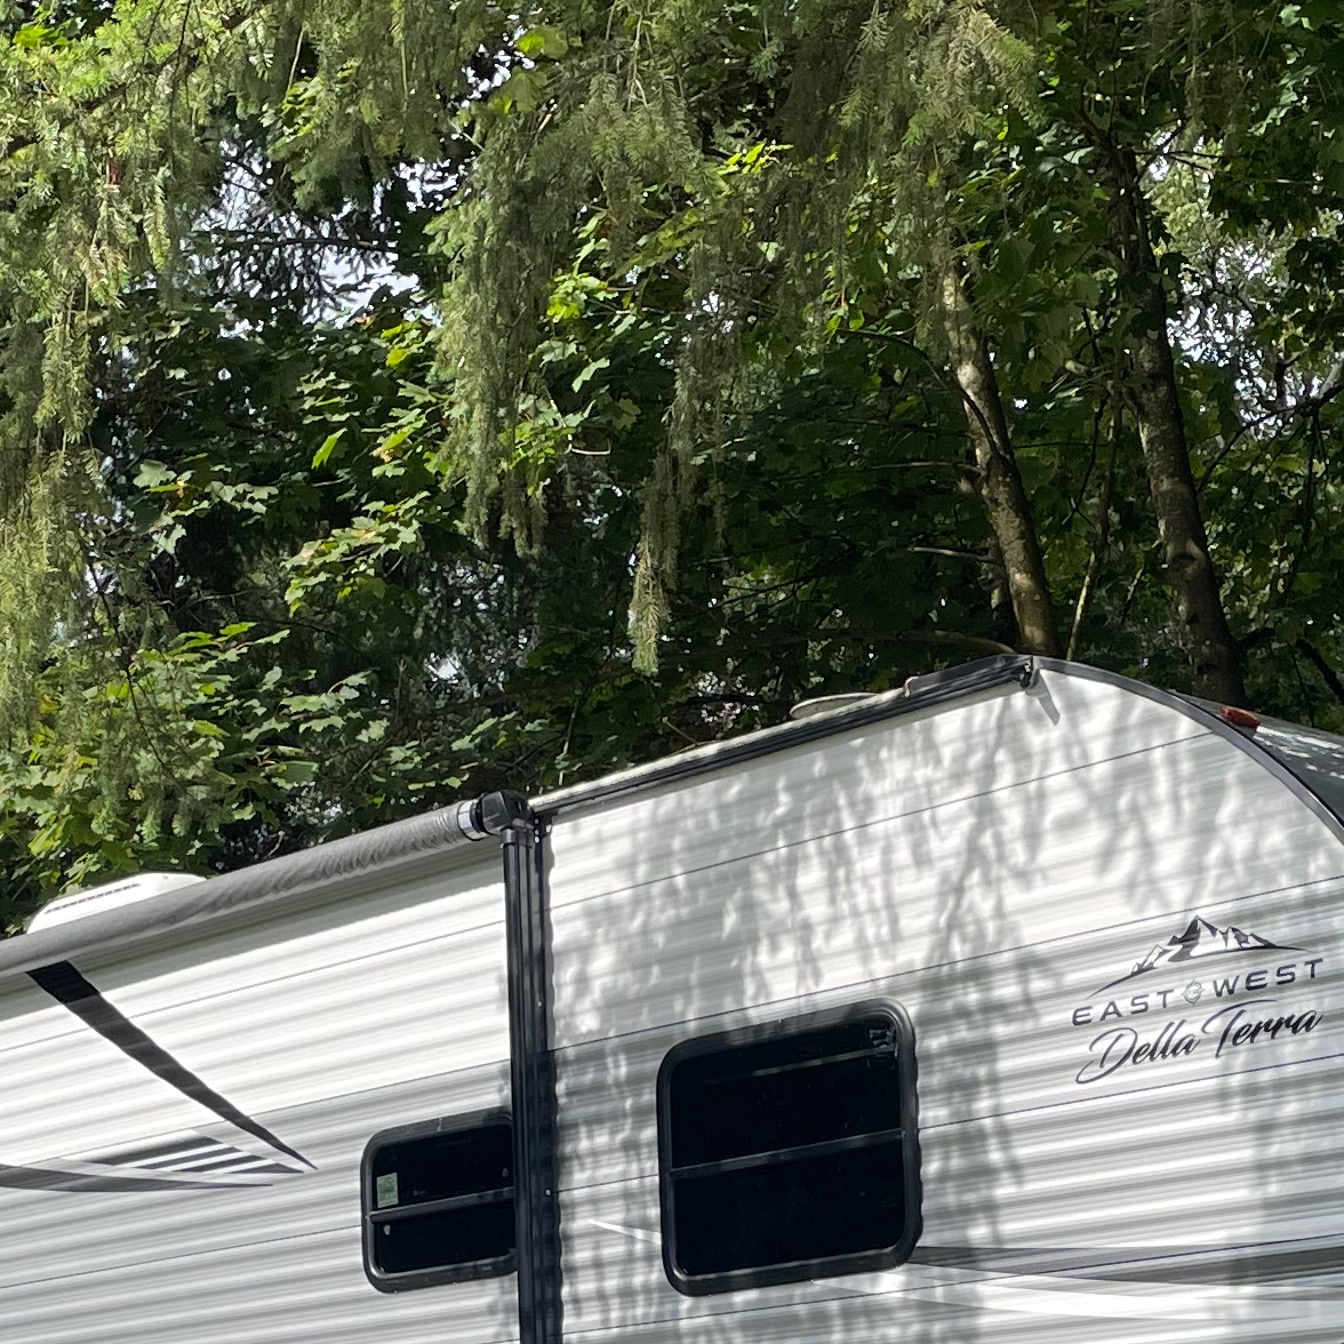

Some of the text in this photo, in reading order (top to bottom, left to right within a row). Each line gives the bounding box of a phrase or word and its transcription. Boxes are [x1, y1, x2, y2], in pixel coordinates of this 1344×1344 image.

[1072, 958, 1324, 1026] EAST WEST
[1074, 999, 1323, 1084] Della Terra
